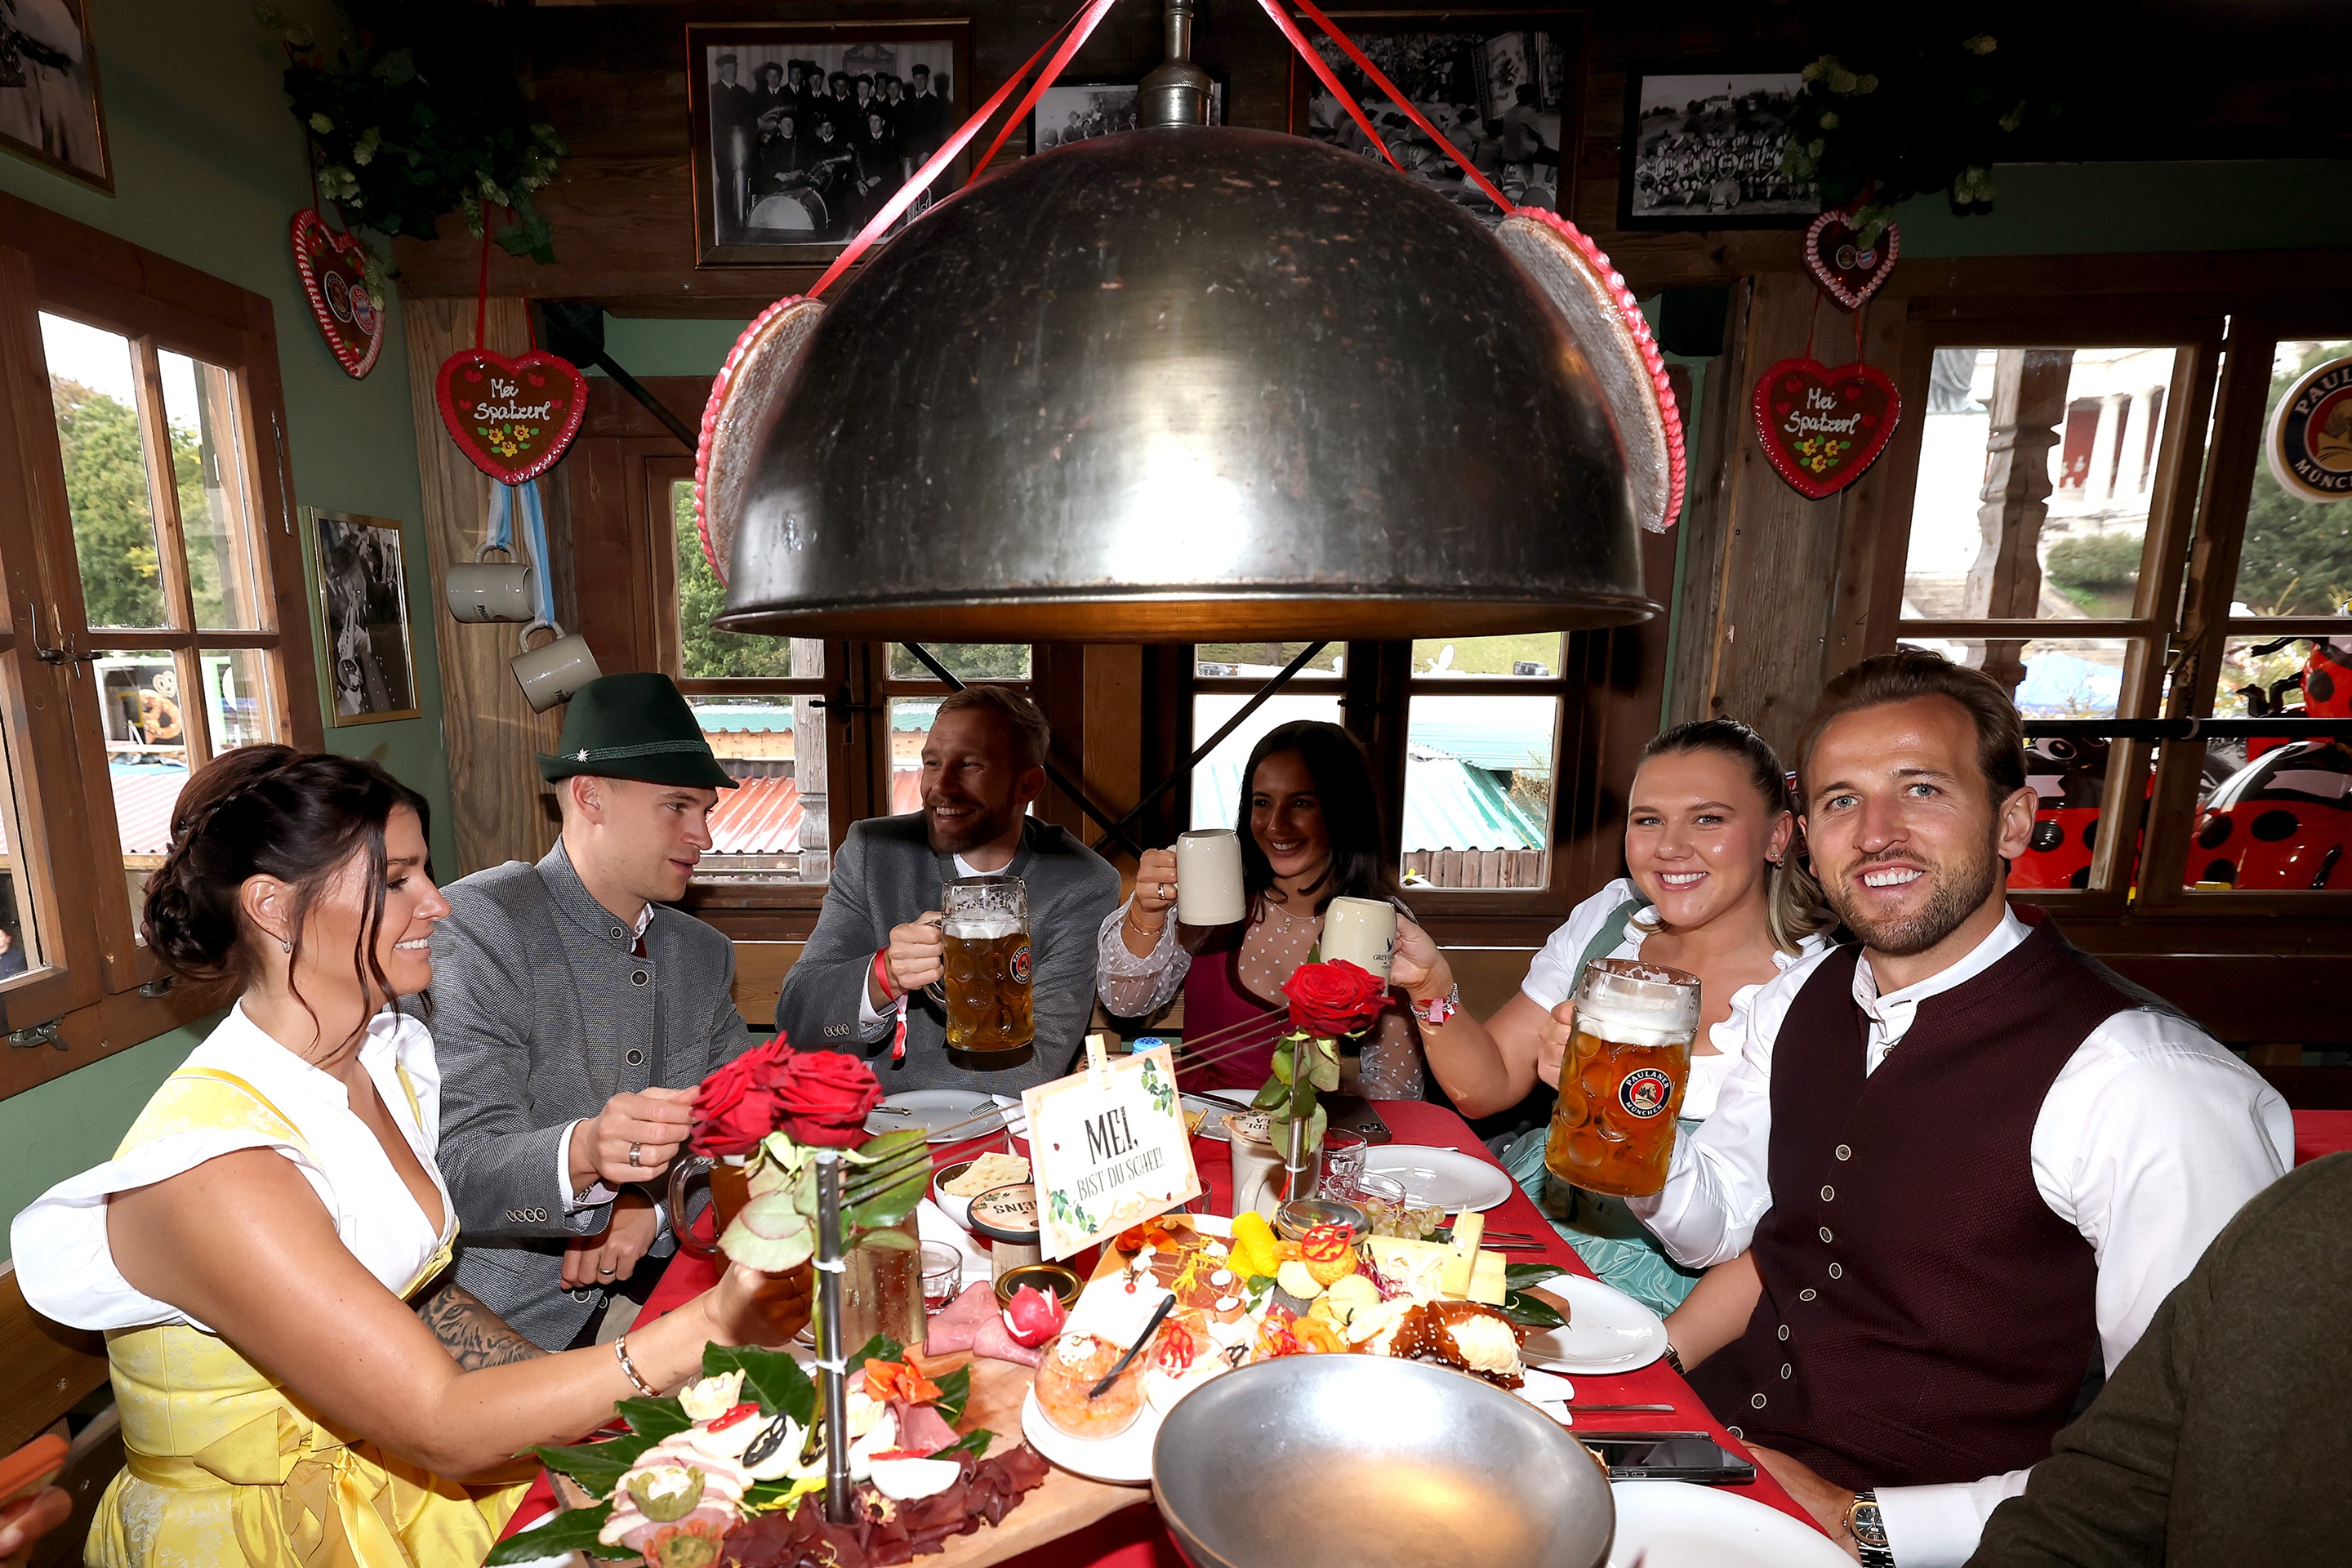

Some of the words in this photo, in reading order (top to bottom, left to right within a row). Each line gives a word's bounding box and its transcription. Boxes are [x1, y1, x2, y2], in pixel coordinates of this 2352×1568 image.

[491, 377, 519, 399] Mei
[1806, 387, 1838, 410] Mei
[2295, 368, 2352, 415] PAUL
[474, 400, 551, 424] Spatzerl
[1784, 411, 1862, 438] Spatzerl
[1625, 1071, 1669, 1089] PAULANER
[1625, 1101, 1663, 1116] MÜNCHEN
[1084, 1106, 1138, 1165] MEI,
[1076, 1171, 1106, 1201] BIST
[1108, 1164, 1125, 1188] DU
[1127, 1147, 1165, 1181] SCHEE!
[992, 1198, 1037, 1214] EINS
